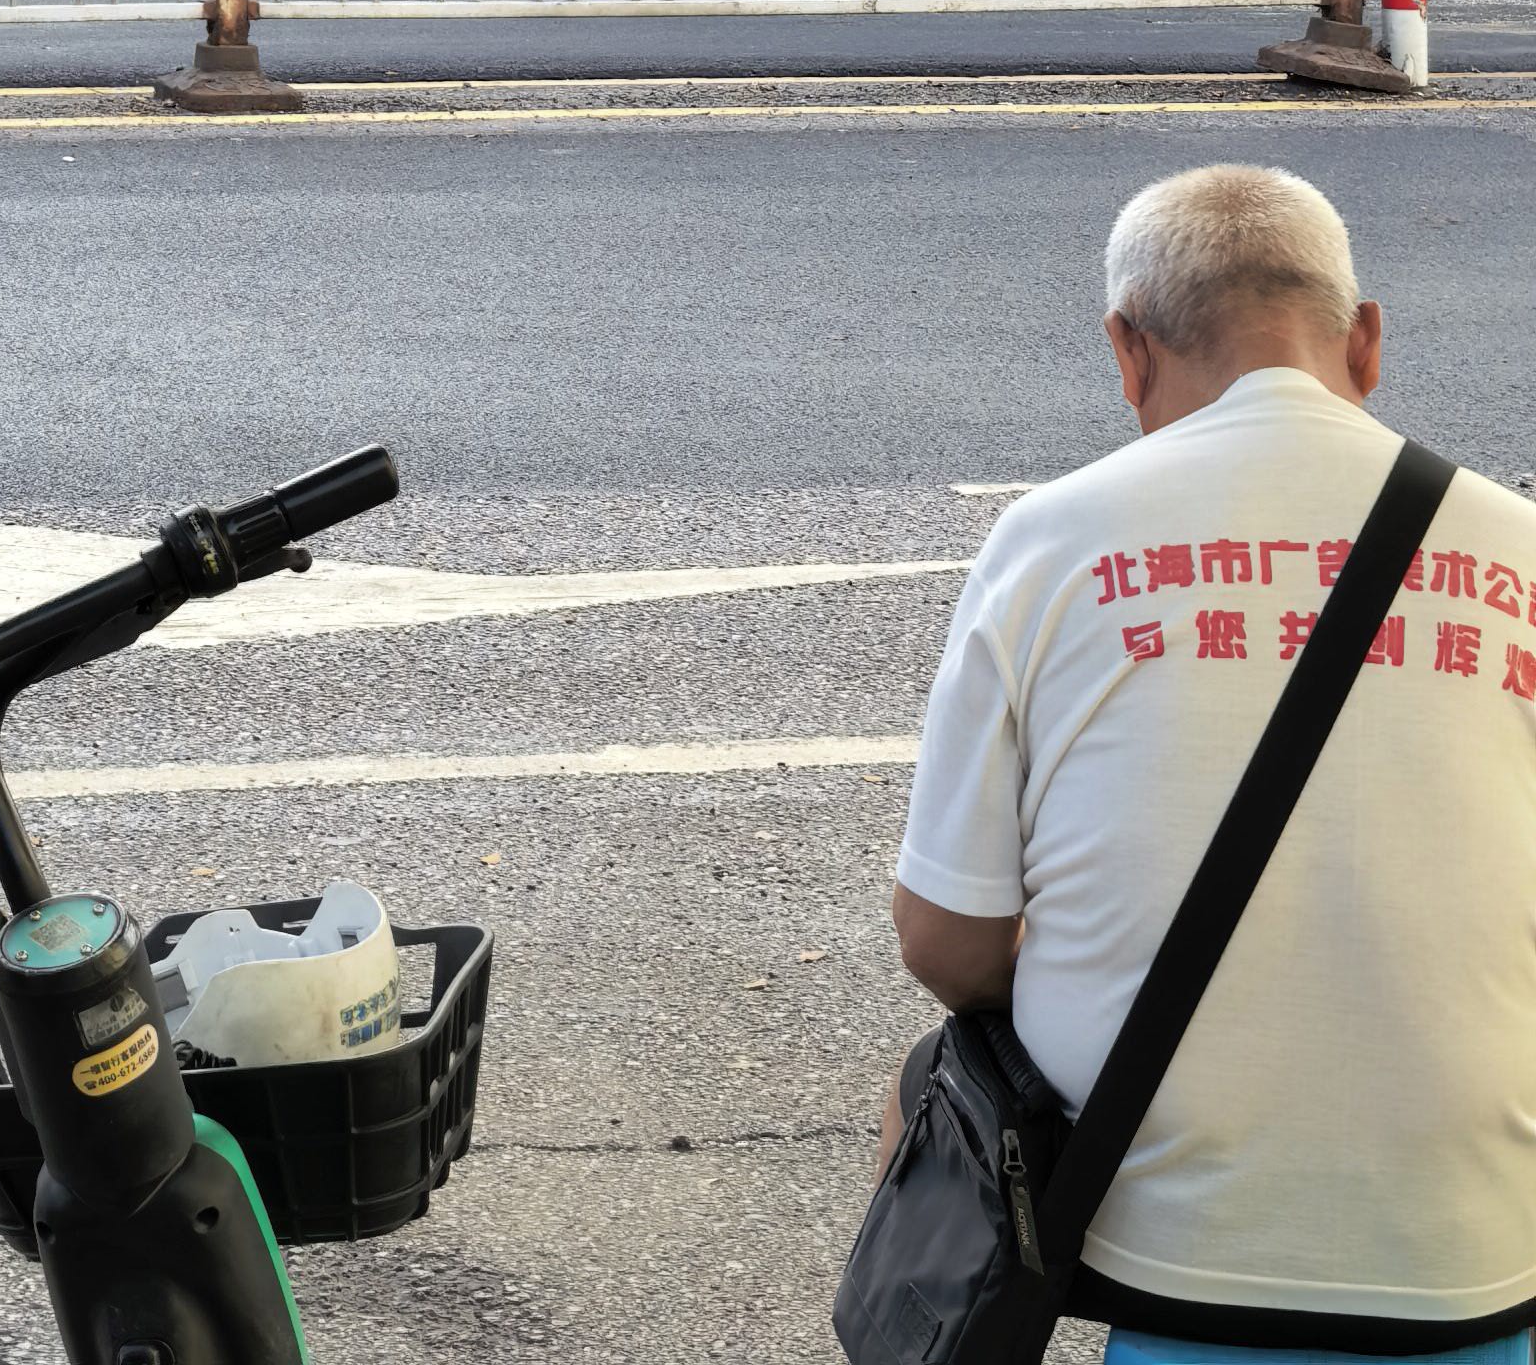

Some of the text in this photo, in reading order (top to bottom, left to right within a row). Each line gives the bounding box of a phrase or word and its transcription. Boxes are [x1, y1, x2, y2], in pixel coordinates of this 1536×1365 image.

[1092, 537, 1536, 627] 北海市广告术公
